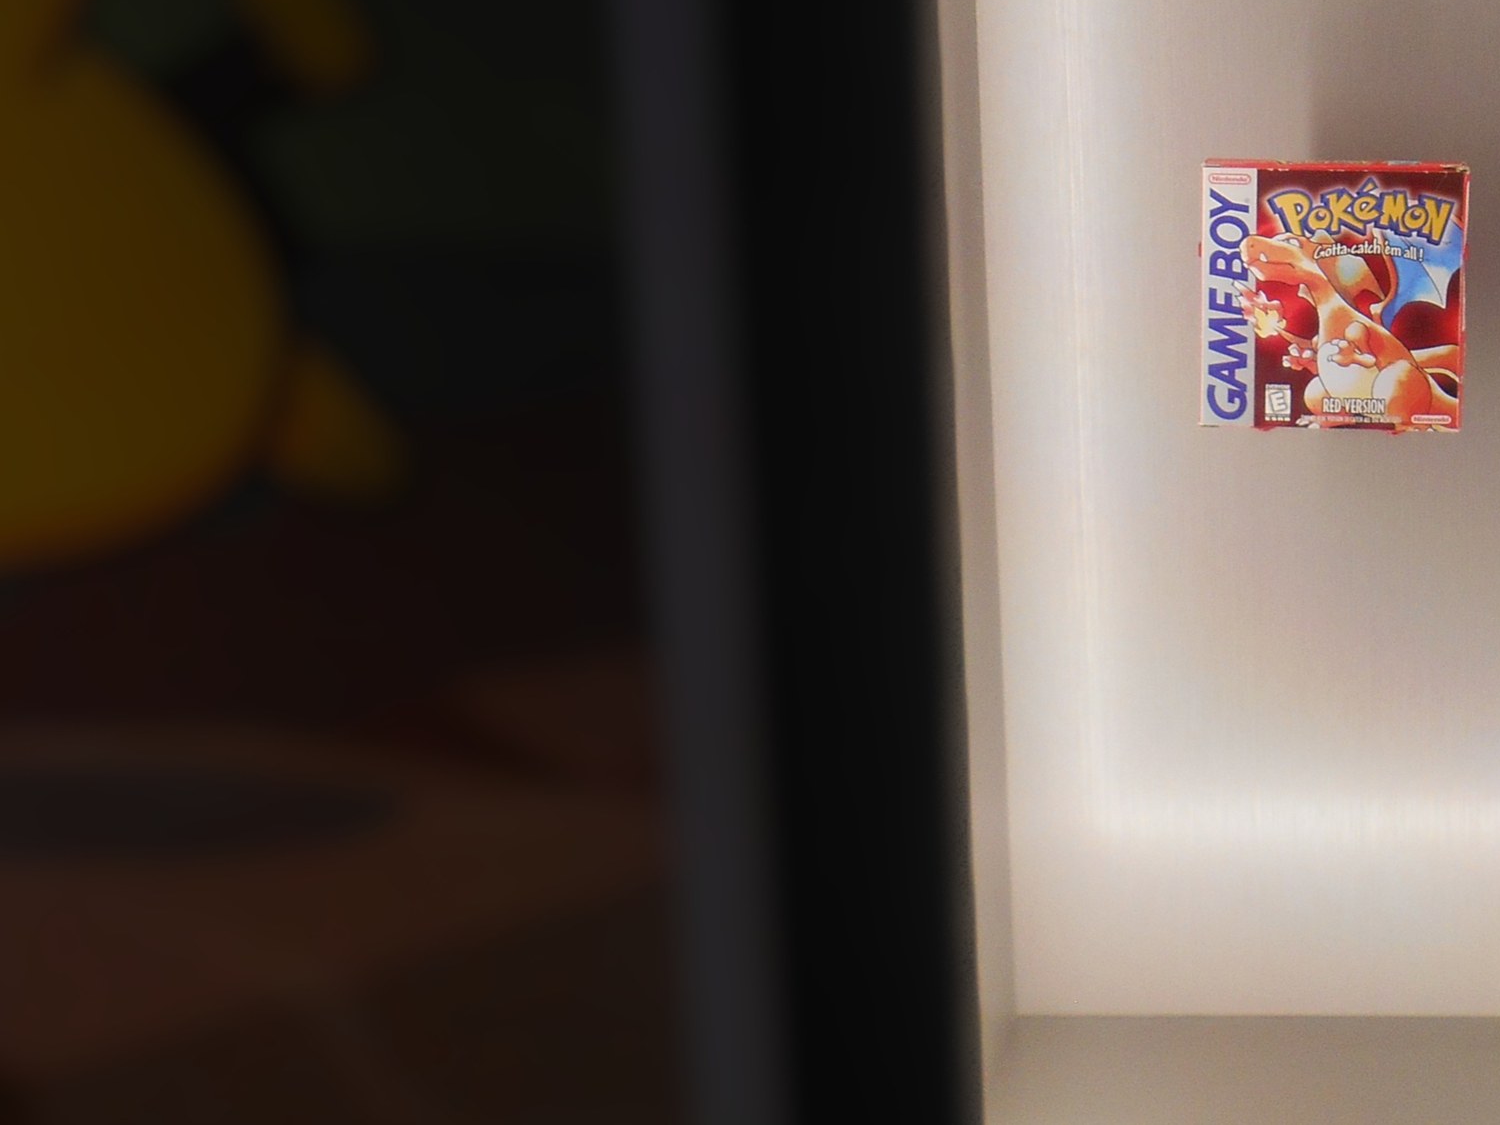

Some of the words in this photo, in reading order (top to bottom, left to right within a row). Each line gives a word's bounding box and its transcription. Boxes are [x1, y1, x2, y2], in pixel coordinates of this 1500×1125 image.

[1209, 188, 1250, 284] BOY
[1313, 243, 1347, 261] Gotta
[1350, 239, 1381, 255] catch
[1207, 285, 1249, 420] GAME
[1269, 391, 1288, 412] E
[1322, 398, 1341, 413] RED
[1344, 398, 1386, 414] VERSION
